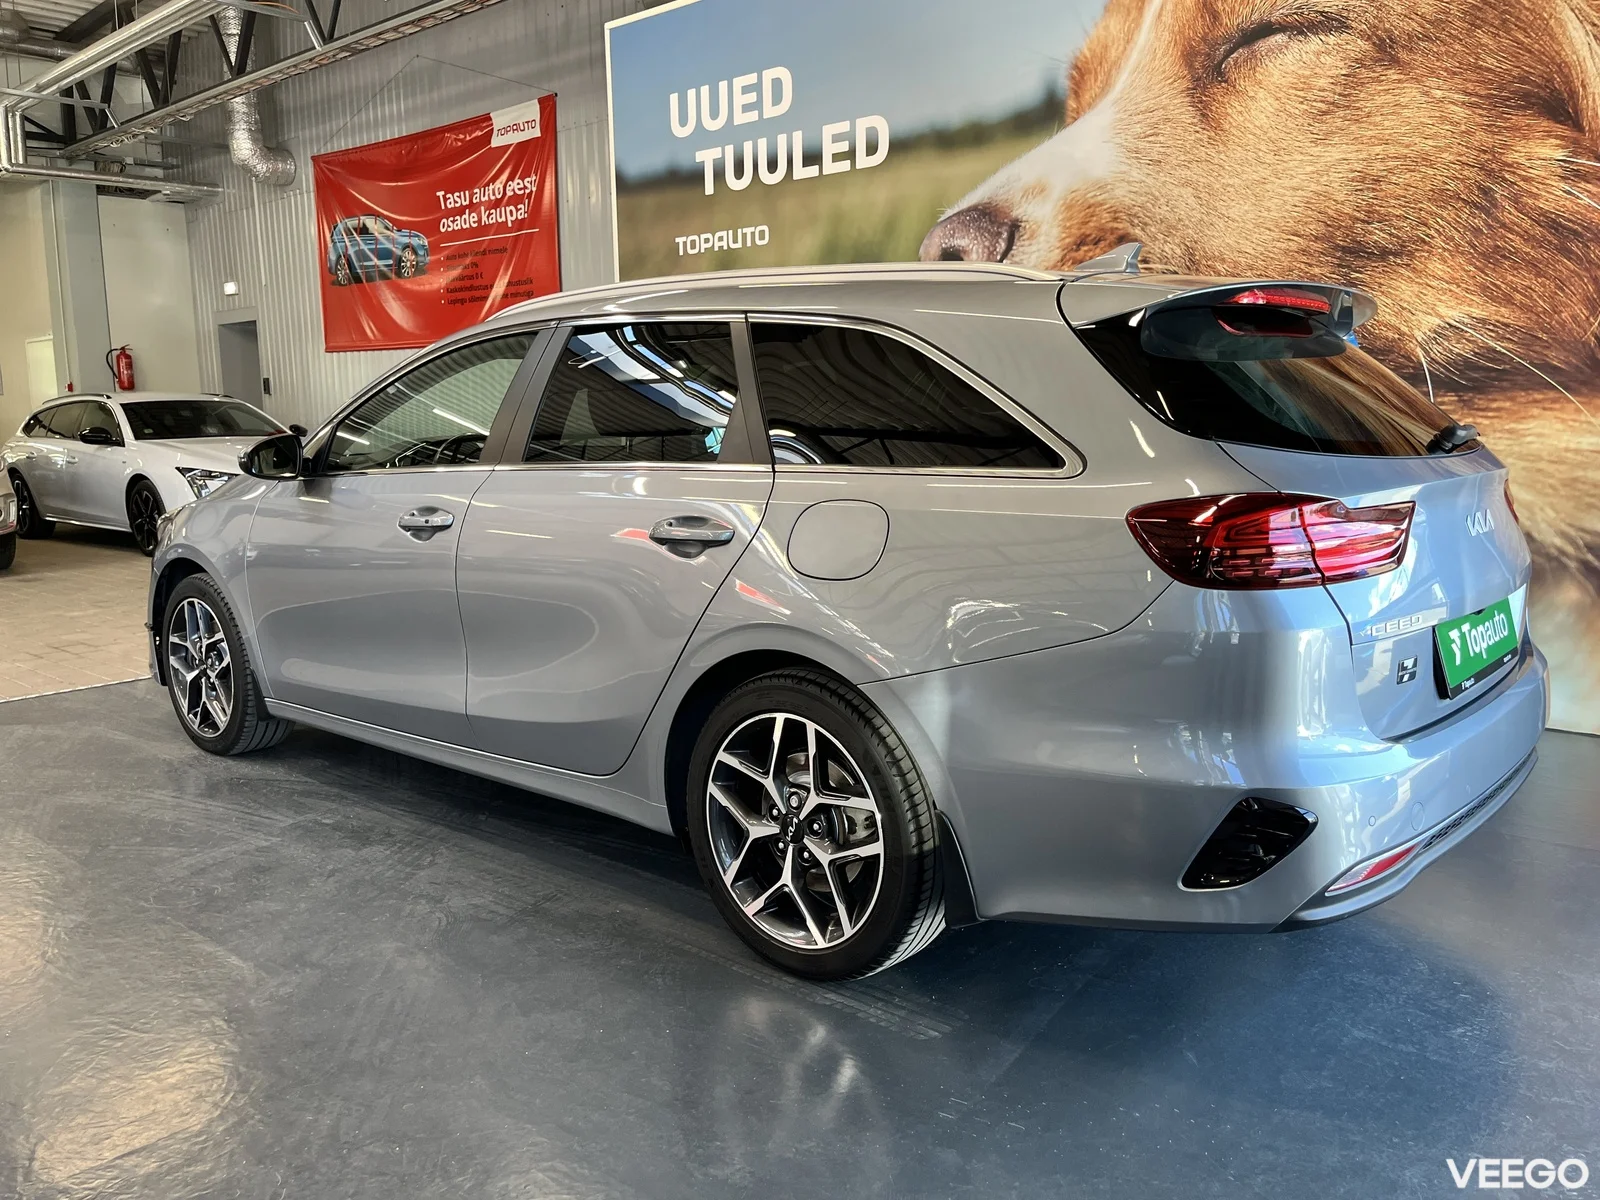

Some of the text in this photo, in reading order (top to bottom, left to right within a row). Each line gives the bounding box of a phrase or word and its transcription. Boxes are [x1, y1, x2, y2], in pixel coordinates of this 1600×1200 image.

[669, 66, 793, 138] UUED
[496, 119, 537, 137] TOPAUTO
[695, 115, 890, 196] TUULED
[436, 174, 537, 210] Tasu auto eest
[440, 199, 529, 233] osade kaupa!
[675, 224, 770, 256] TOPAUTO
[1461, 610, 1509, 659] Topauto
